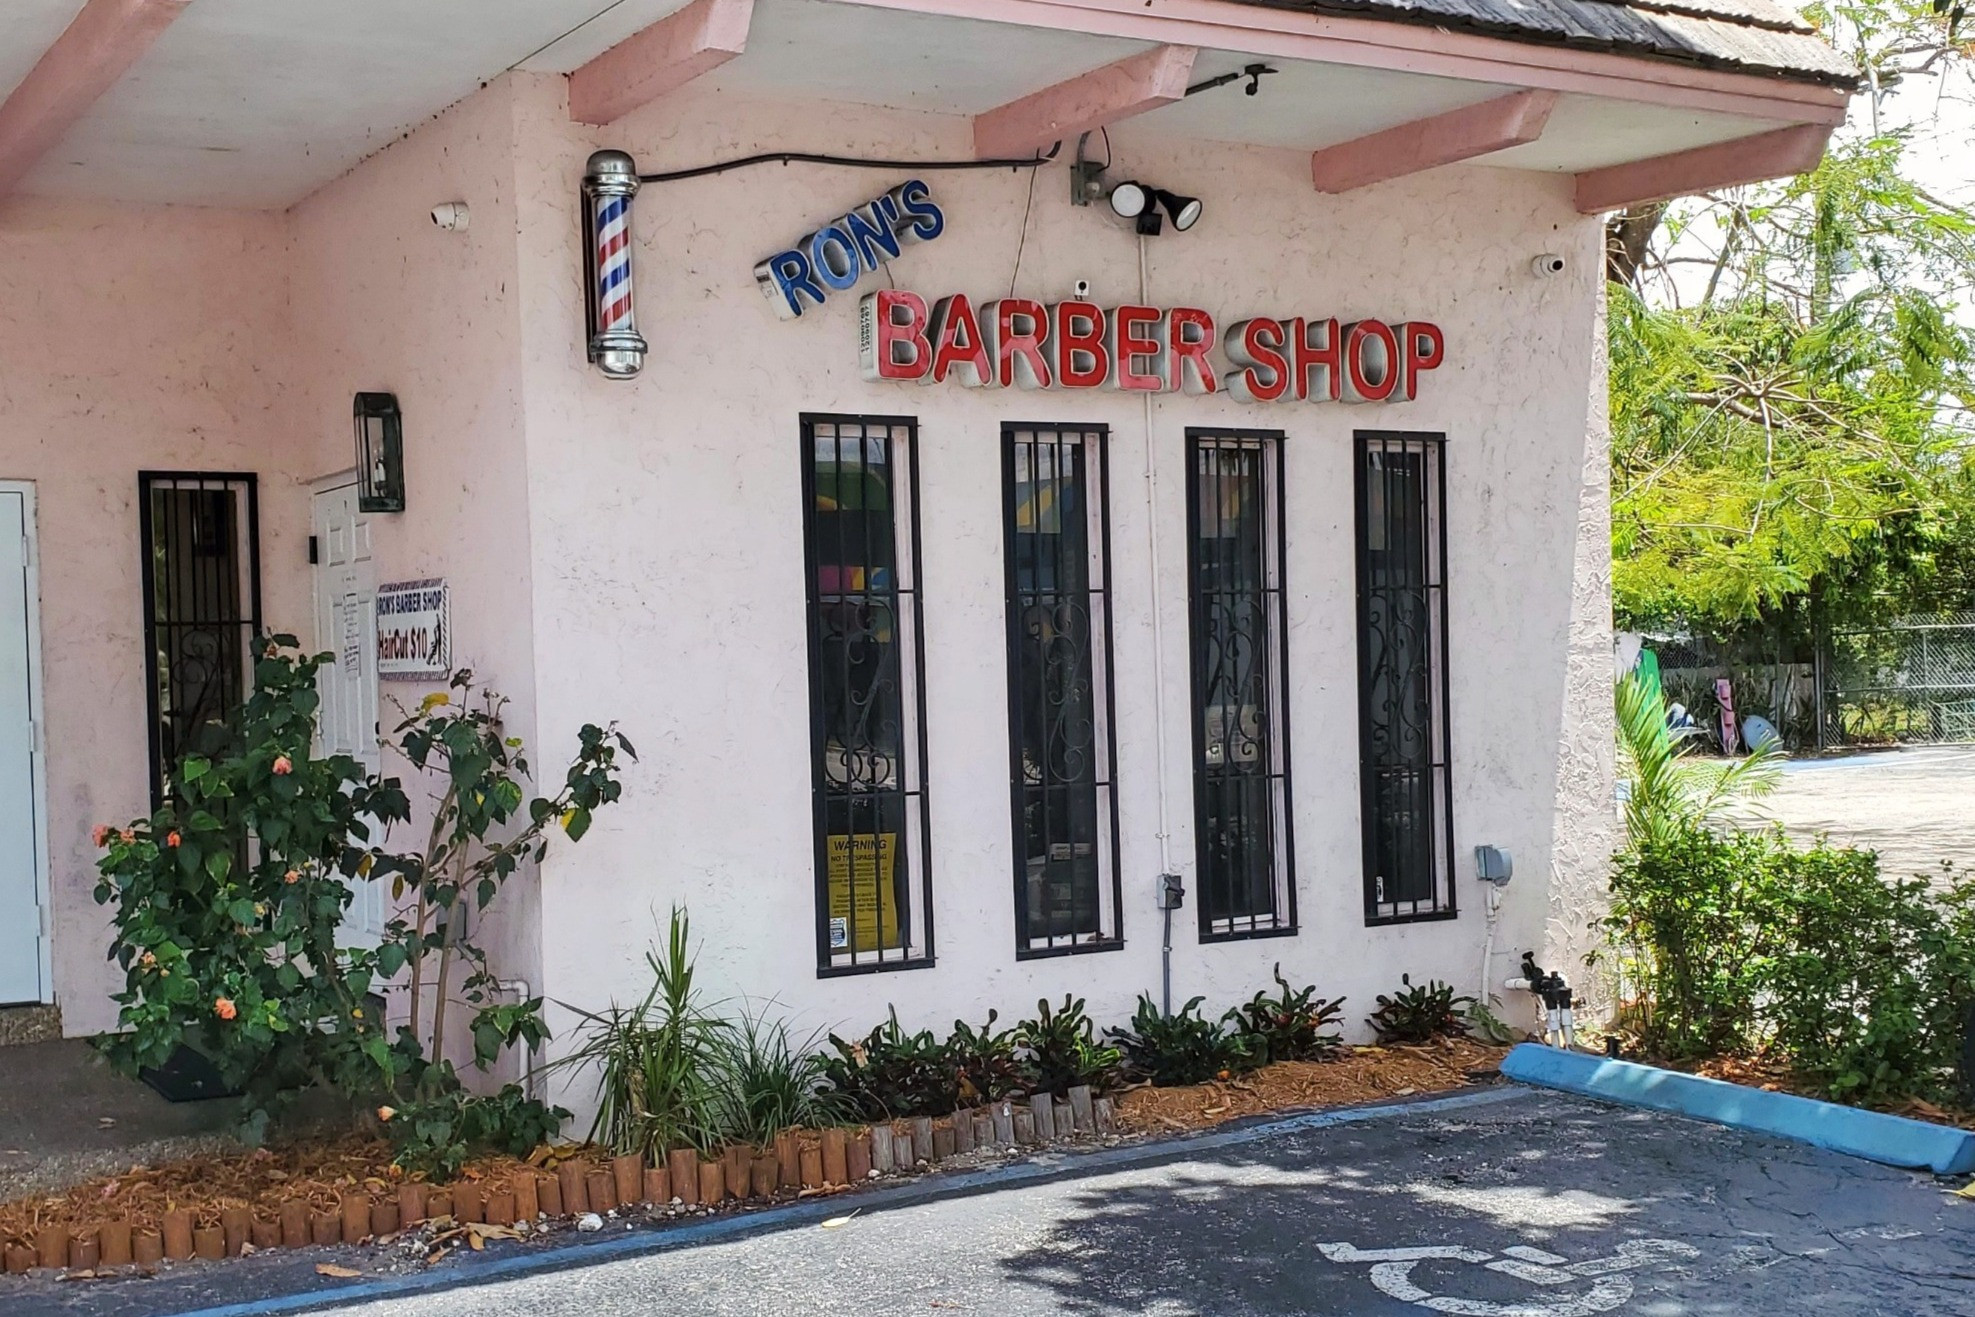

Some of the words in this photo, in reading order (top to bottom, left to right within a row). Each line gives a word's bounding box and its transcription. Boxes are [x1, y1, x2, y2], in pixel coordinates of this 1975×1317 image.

[767, 178, 946, 317] RON'S
[875, 288, 1218, 395] BARBER
[1236, 315, 1445, 402] SHOP
[379, 595, 395, 616] RON'S
[396, 592, 422, 614] BARBER
[422, 590, 442, 612] SHOP
[379, 628, 409, 660] HairCut
[411, 626, 428, 662] $10
[834, 839, 887, 851] WARNING
